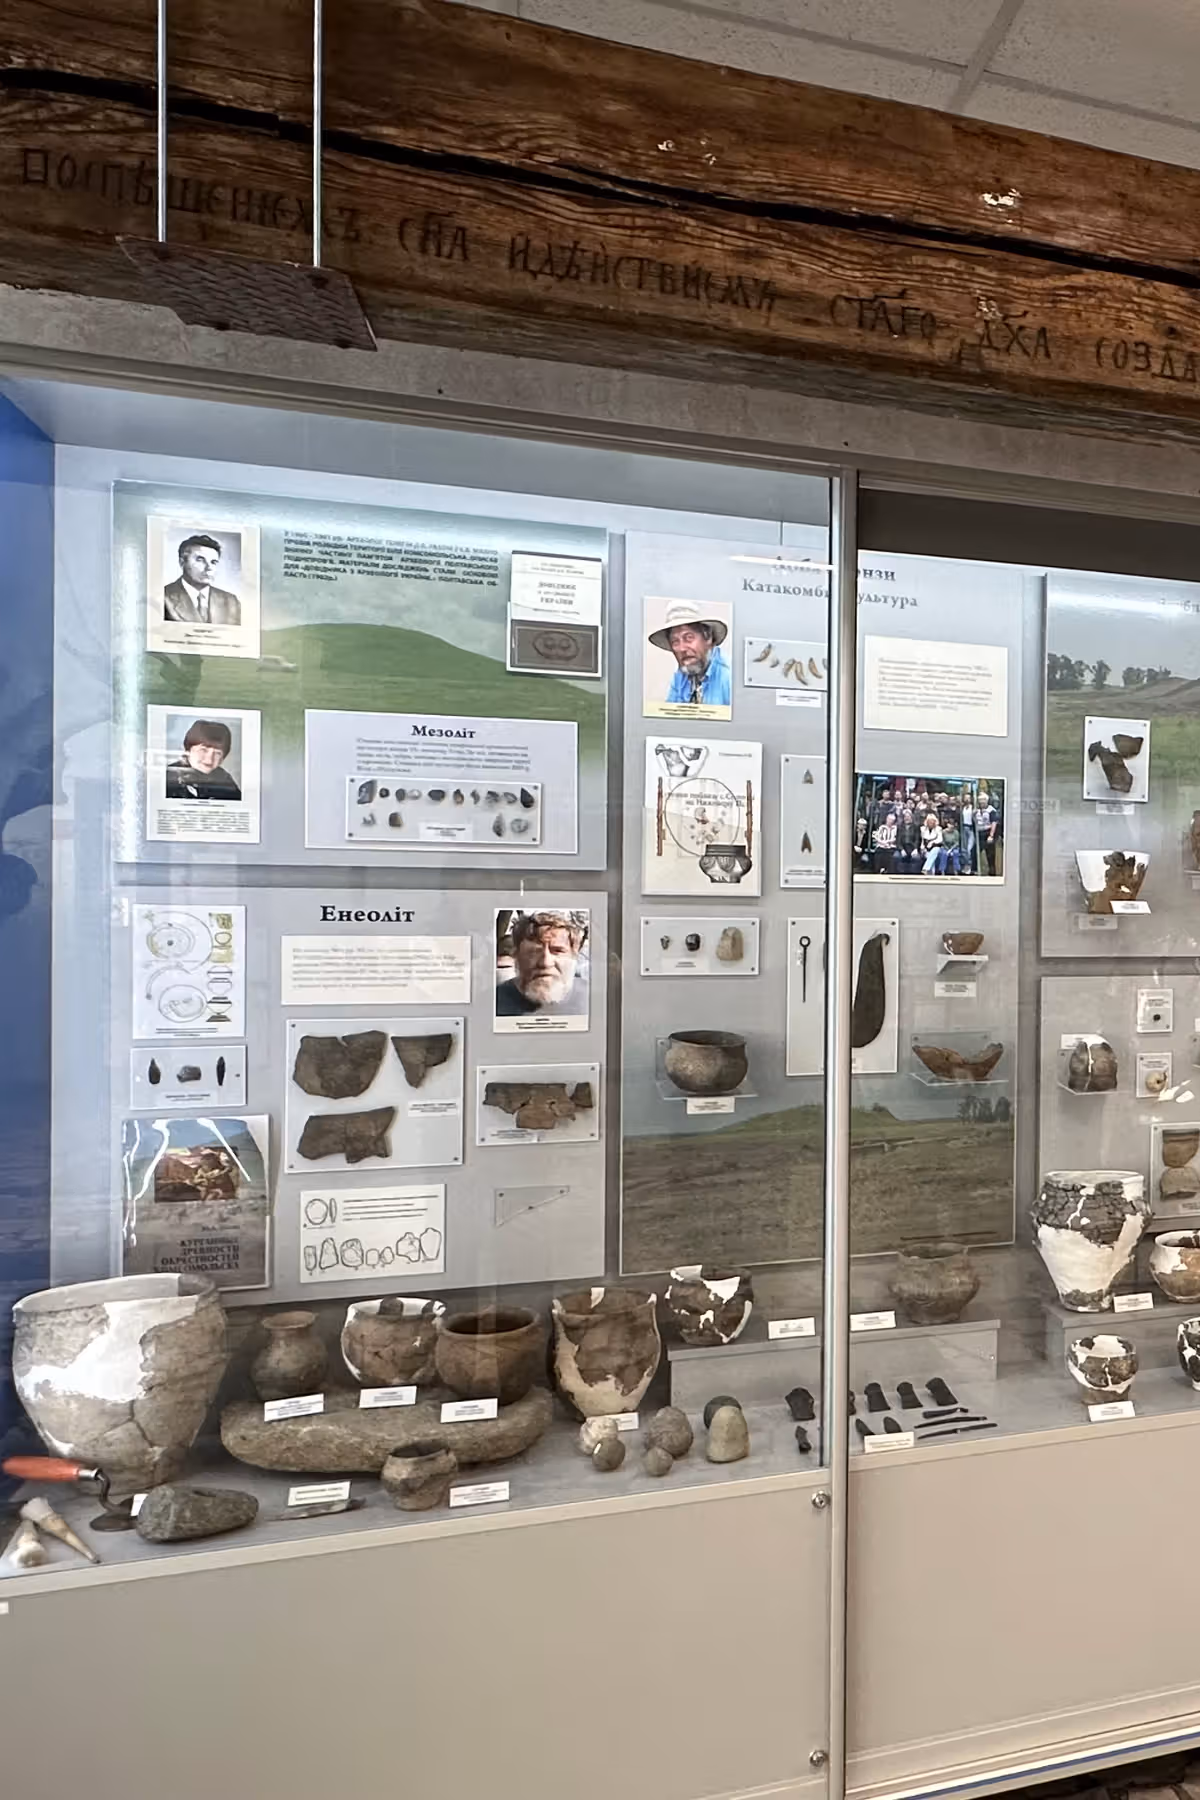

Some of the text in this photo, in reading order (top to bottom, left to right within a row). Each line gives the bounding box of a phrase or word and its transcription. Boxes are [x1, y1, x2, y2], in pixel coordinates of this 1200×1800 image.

[742, 578, 918, 610] Катакомб ультура
[411, 724, 477, 739] Мезоліт
[320, 905, 415, 923] Енеоліт
